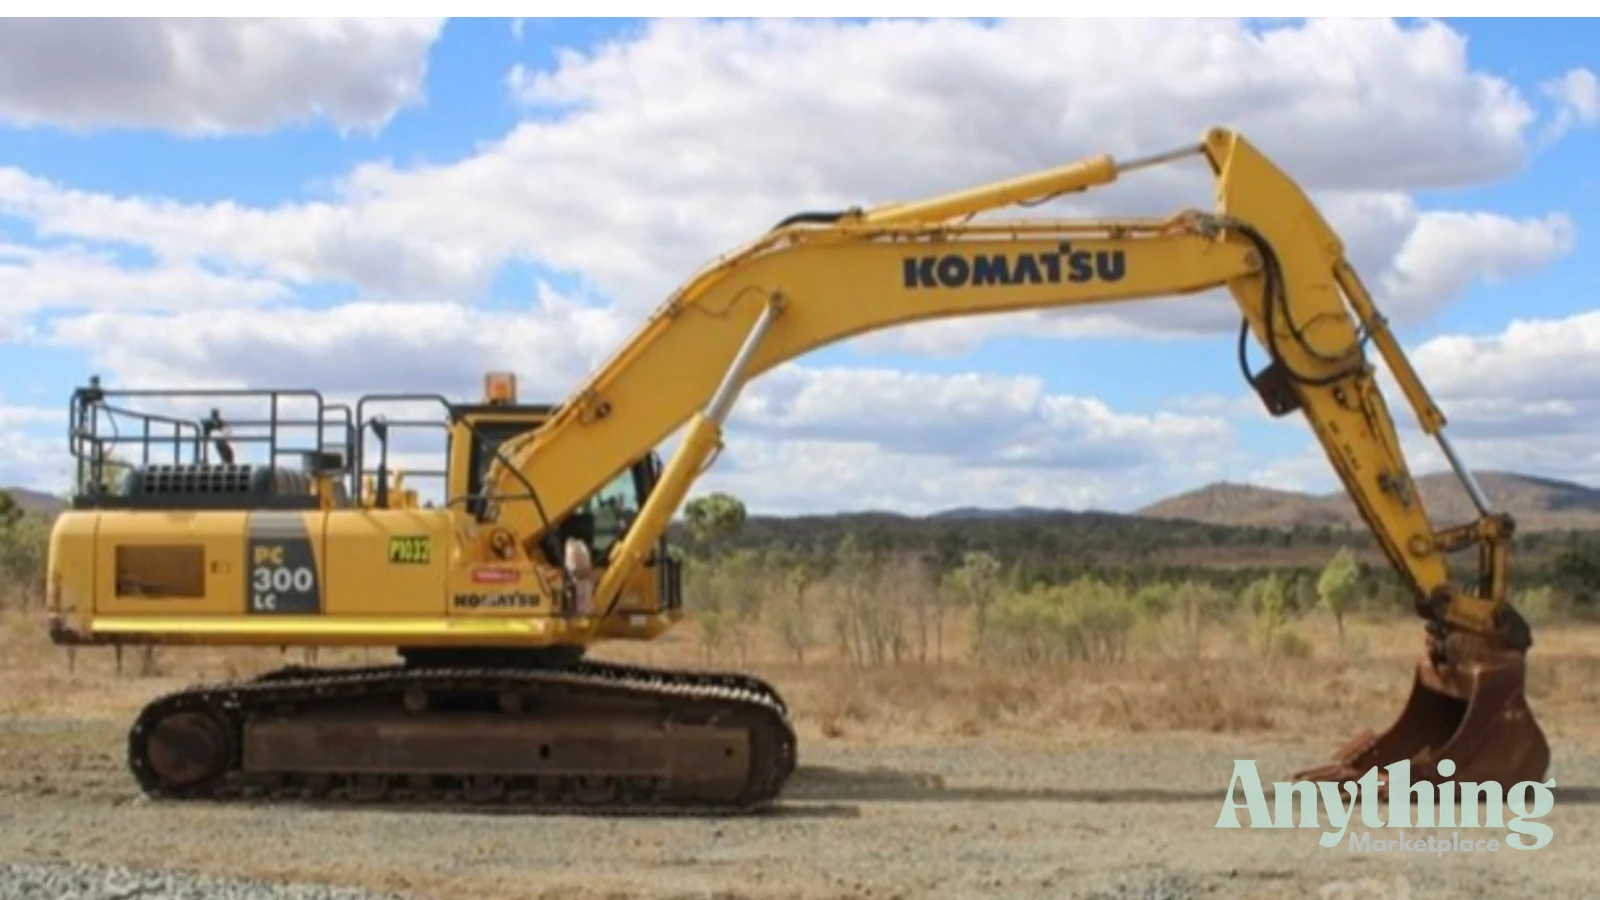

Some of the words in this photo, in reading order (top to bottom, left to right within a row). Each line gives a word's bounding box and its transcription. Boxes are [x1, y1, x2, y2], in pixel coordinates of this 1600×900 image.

[904, 241, 1125, 288] KOMATSU
[254, 547, 285, 564] PC
[253, 567, 314, 591] 300
[254, 594, 277, 610] LC
